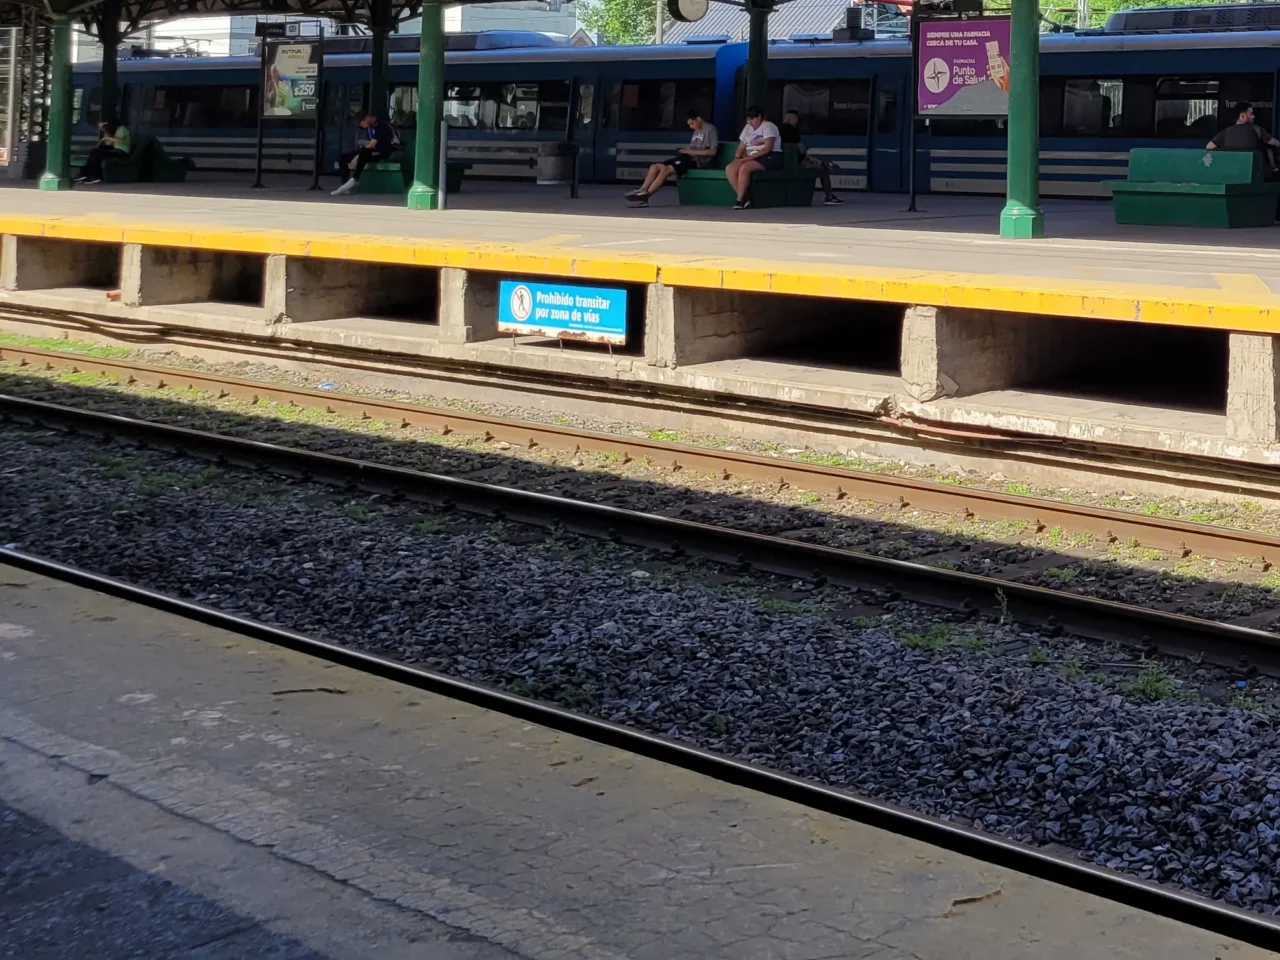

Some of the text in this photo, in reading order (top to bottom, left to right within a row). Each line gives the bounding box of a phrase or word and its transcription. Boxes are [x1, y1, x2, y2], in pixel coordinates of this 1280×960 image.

[926, 31, 950, 39] SIEMPRE
[964, 30, 991, 38] FARMACIA
[926, 39, 945, 47] CERCA
[953, 65, 976, 75] Punto
[953, 75, 986, 85] de Salud
[294, 84, 315, 96] $250
[536, 291, 611, 310] Prohibido transitar
[535, 308, 600, 323] por zona de vías
